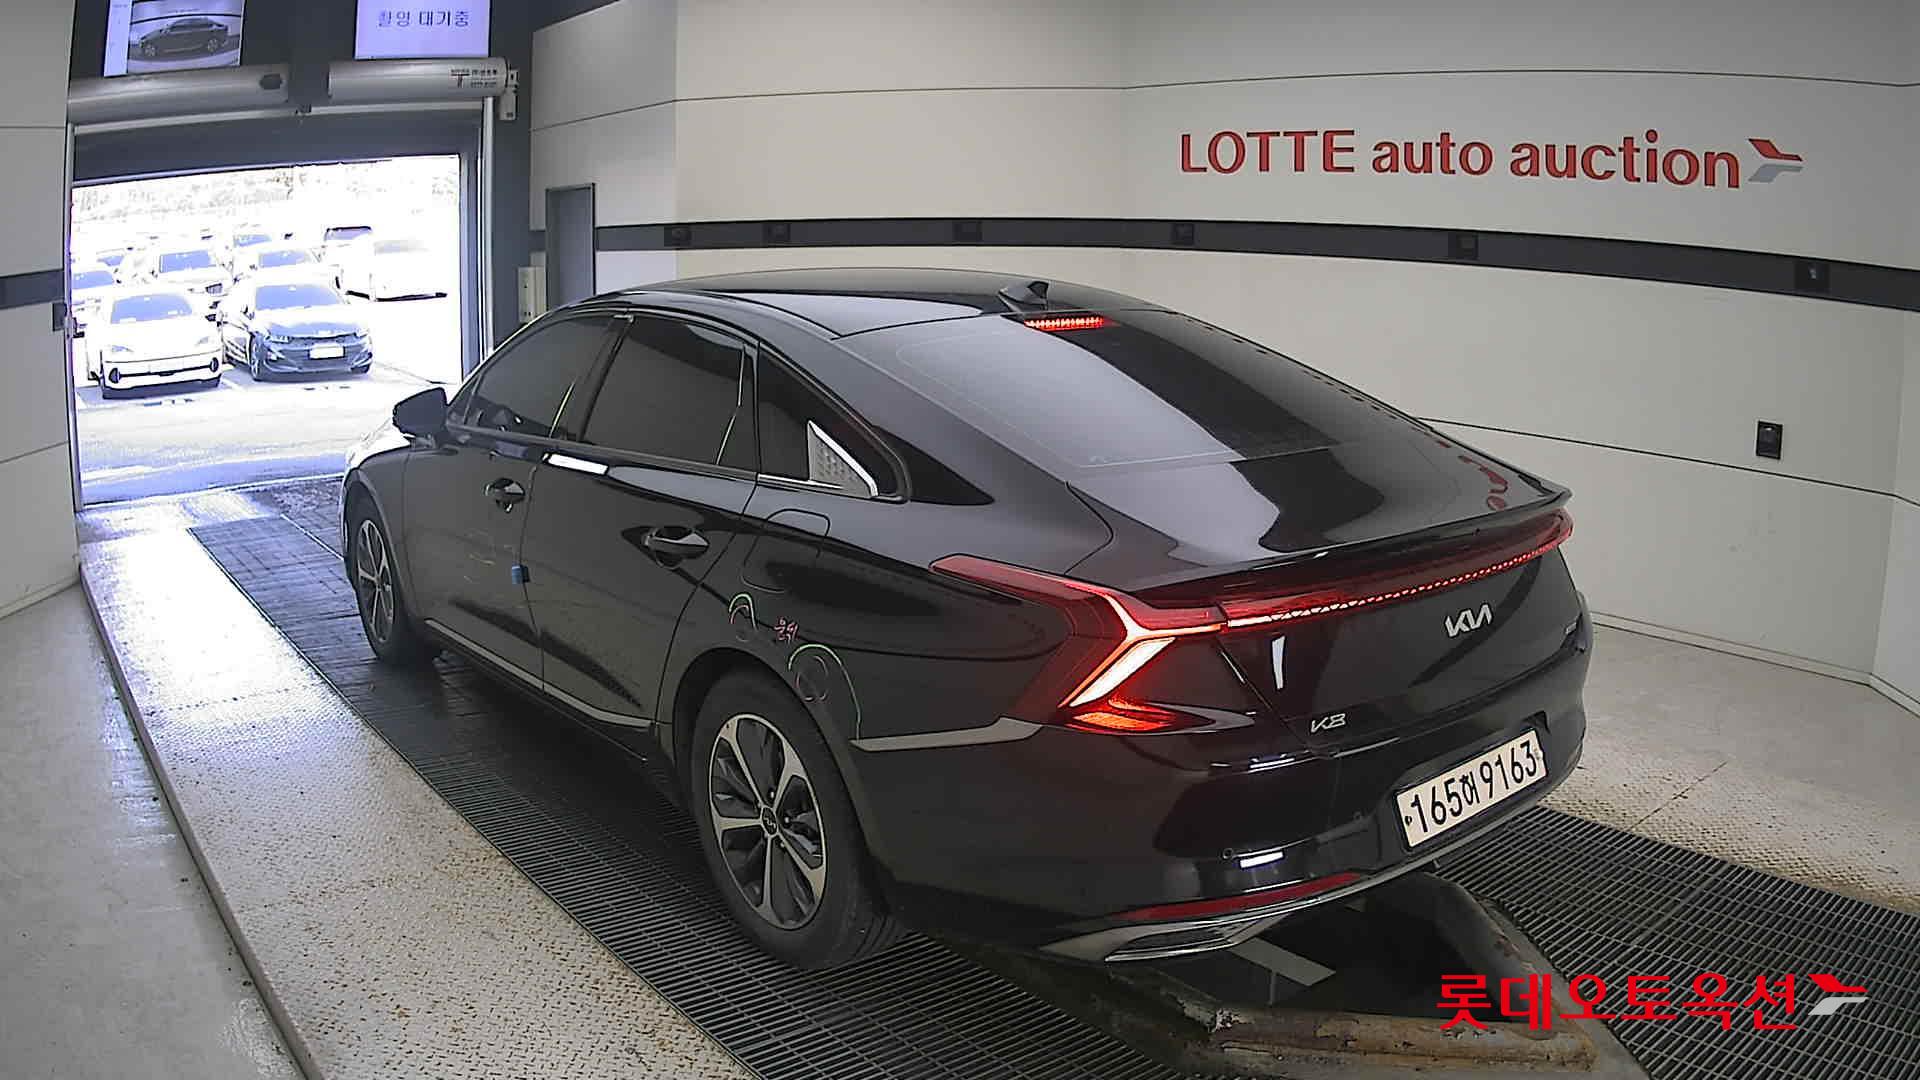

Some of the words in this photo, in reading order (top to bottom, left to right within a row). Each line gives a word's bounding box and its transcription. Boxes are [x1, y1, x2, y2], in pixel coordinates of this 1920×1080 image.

[418, 10, 469, 28] 대기중
[1180, 129, 1355, 174] LOTTE
[1372, 132, 1494, 175] auto
[1510, 129, 1740, 188] auction
[1444, 603, 1493, 638] KIA
[1310, 713, 1346, 733] K8
